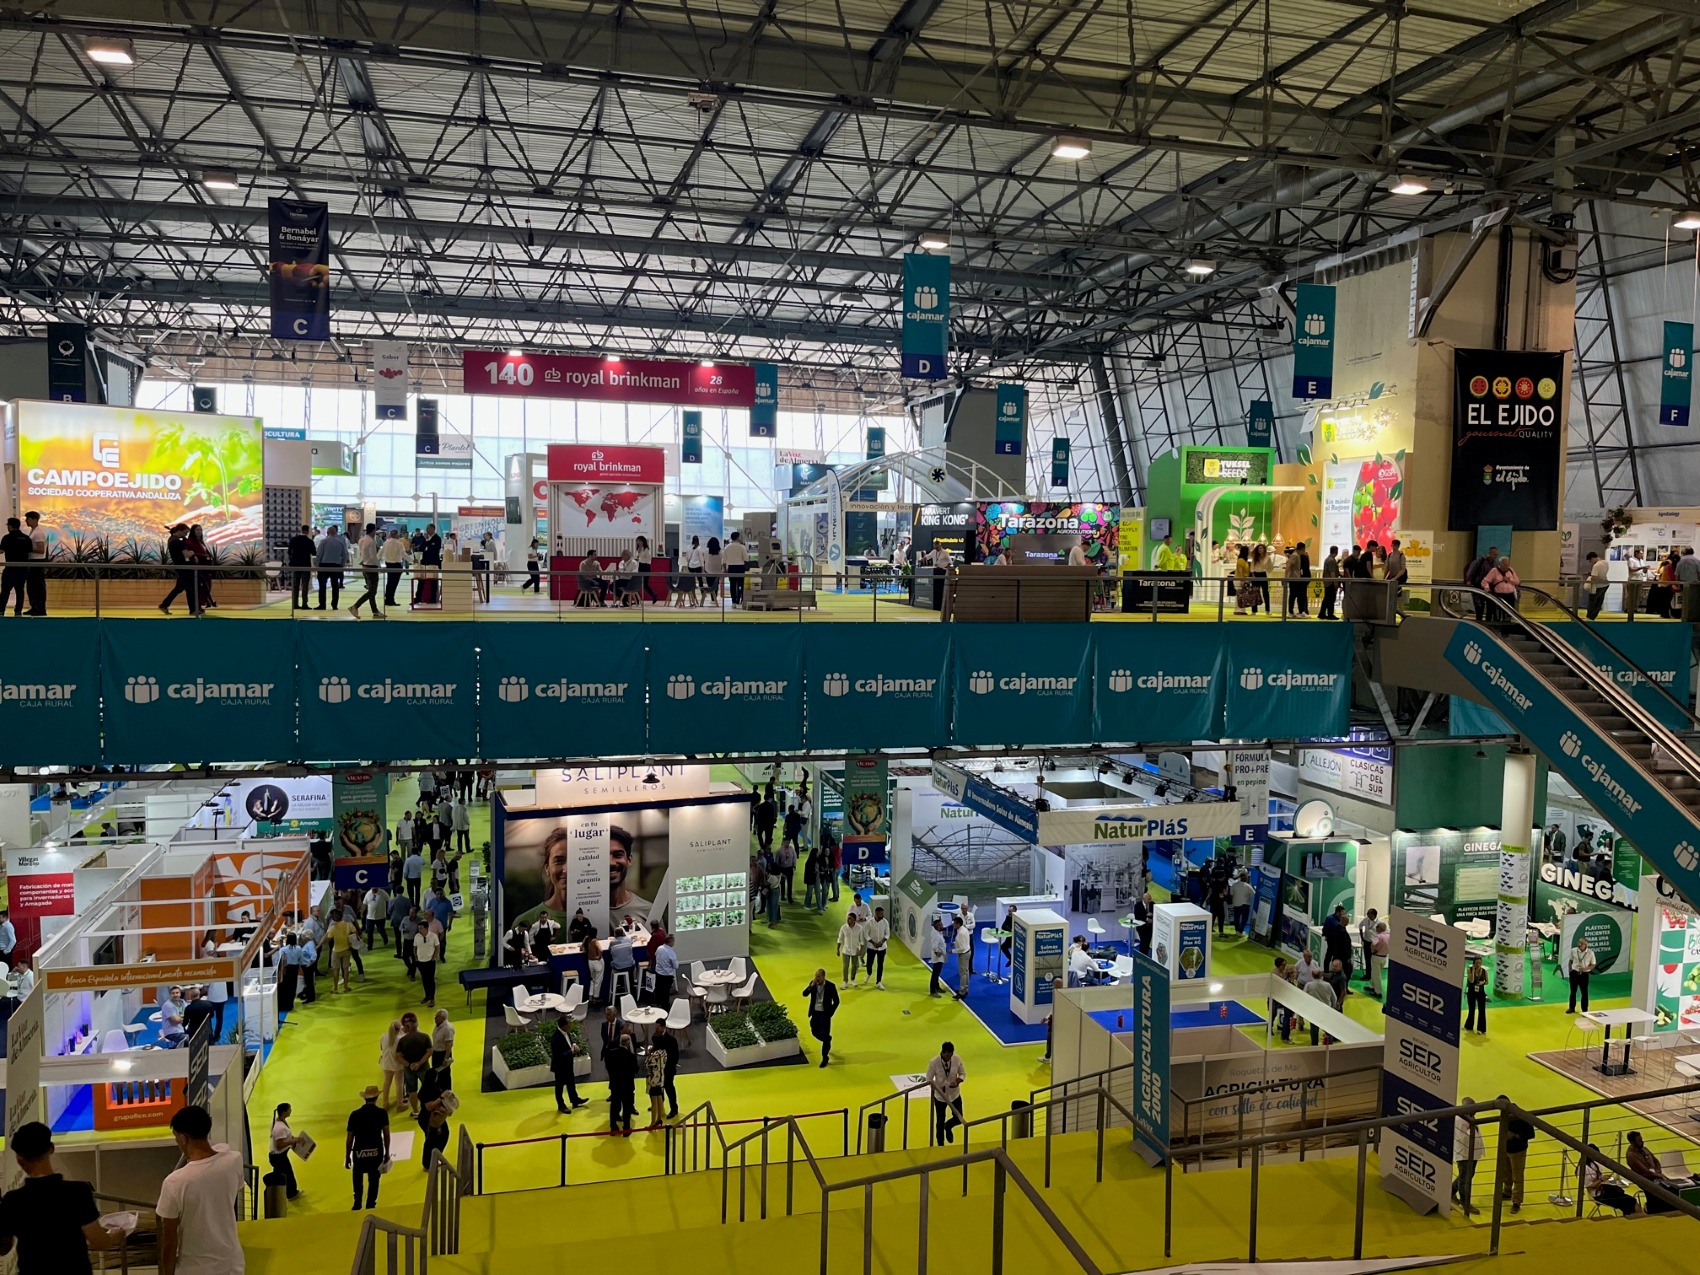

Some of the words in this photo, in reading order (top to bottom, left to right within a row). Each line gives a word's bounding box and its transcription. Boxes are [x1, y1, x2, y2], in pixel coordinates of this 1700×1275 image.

[281, 226, 317, 235] Bernabel
[906, 310, 945, 322] cajamar
[293, 318, 308, 335] C
[1298, 336, 1330, 347] cajamar
[918, 360, 930, 374] D
[484, 362, 534, 386] 140
[566, 370, 604, 388] royal
[610, 370, 680, 389] brinkman
[709, 375, 723, 385] 28
[1664, 368, 1689, 380] cajamar
[1308, 382, 1317, 394] E
[62, 394, 72, 402] B
[387, 408, 396, 418] C
[1468, 403, 1492, 425] EL
[1498, 404, 1554, 427] EJIDO
[1670, 410, 1678, 421] F
[760, 426, 767, 435] D
[1458, 426, 1534, 446] gourmet
[1518, 430, 1553, 440] QUALITY
[1005, 442, 1012, 452] E
[574, 462, 596, 472] royal
[600, 462, 641, 472] brinkman
[1222, 468, 1248, 478] SEEDS
[27, 468, 182, 490] CAMPOEJIDO
[28, 487, 74, 497] SOCIEDAD
[75, 488, 136, 499] COOPERATIVA
[136, 490, 182, 500] ANDALUZA
[850, 502, 890, 510] innovación
[891, 504, 896, 512] y
[921, 507, 950, 515] TARAVERT
[921, 515, 940, 526] KING
[998, 513, 1079, 529] Tarazona
[854, 672, 936, 698] cajamar
[999, 672, 1078, 695] cajamar
[1137, 670, 1211, 693] cajamar
[1267, 668, 1338, 691] cajamar
[1481, 660, 1533, 710] cajamar
[166, 677, 274, 704] cajamar
[356, 678, 457, 704] cajamar
[534, 678, 628, 703] cajamar
[700, 675, 788, 701] cajamar
[45, 700, 74, 708] RURAL
[220, 698, 244, 706] CAJA
[247, 698, 272, 706] RURAL
[406, 698, 429, 706] CAJA
[432, 698, 454, 706] RURAL
[1235, 752, 1269, 762] FÓRMULA
[1234, 765, 1269, 774] PRO+PRE
[1350, 759, 1384, 774] CLASICAS
[561, 765, 685, 782] SALIPLANT
[1369, 774, 1384, 785] DEL
[584, 782, 666, 795] SEMILLEROS
[1248, 779, 1267, 787] pepino
[1368, 784, 1383, 794] SUR
[1581, 754, 1642, 815] cajamar
[292, 794, 326, 802] SERAFINA
[574, 828, 604, 840] lugar
[1094, 818, 1188, 840] NaturPláS
[1245, 829, 1254, 841] E
[689, 838, 732, 848] SALIPLANT
[858, 847, 869, 860] D
[355, 870, 369, 884] C
[1404, 926, 1448, 958] SER
[1404, 946, 1448, 968] AGRICULTOR
[1402, 982, 1445, 1016] SER
[1141, 976, 1152, 1116] AGRICULTURA
[1399, 1038, 1442, 1074] SER
[1230, 1068, 1270, 1077] Roquetas
[1272, 1065, 1283, 1073] de
[1285, 1064, 1300, 1072] Mar
[1398, 1056, 1441, 1084] AGRICULTOR
[1151, 1072, 1162, 1125] 2000
[1208, 1105, 1228, 1117] con
[356, 1148, 379, 1159] VANS
[1394, 1145, 1436, 1184] SER
[1394, 1164, 1436, 1192] AGRICULTOR
